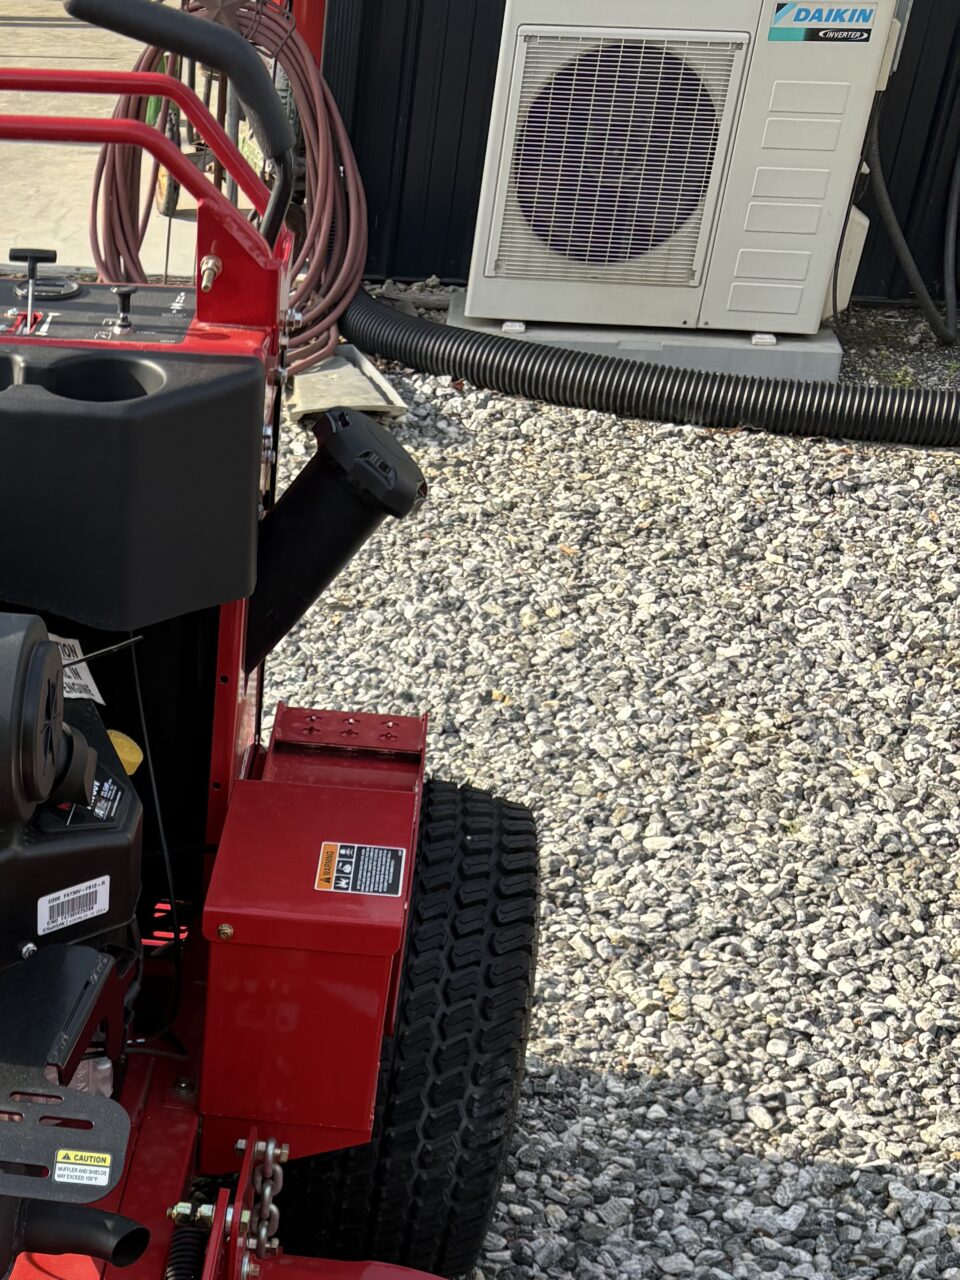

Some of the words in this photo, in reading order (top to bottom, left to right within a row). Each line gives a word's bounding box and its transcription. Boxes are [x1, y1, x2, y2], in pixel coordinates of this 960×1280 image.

[793, 7, 874, 23] DAIKIN
[826, 29, 861, 39] INVERTER
[74, 1153, 107, 1164] CAUTION
[57, 1166, 78, 1174] MUFFLER
